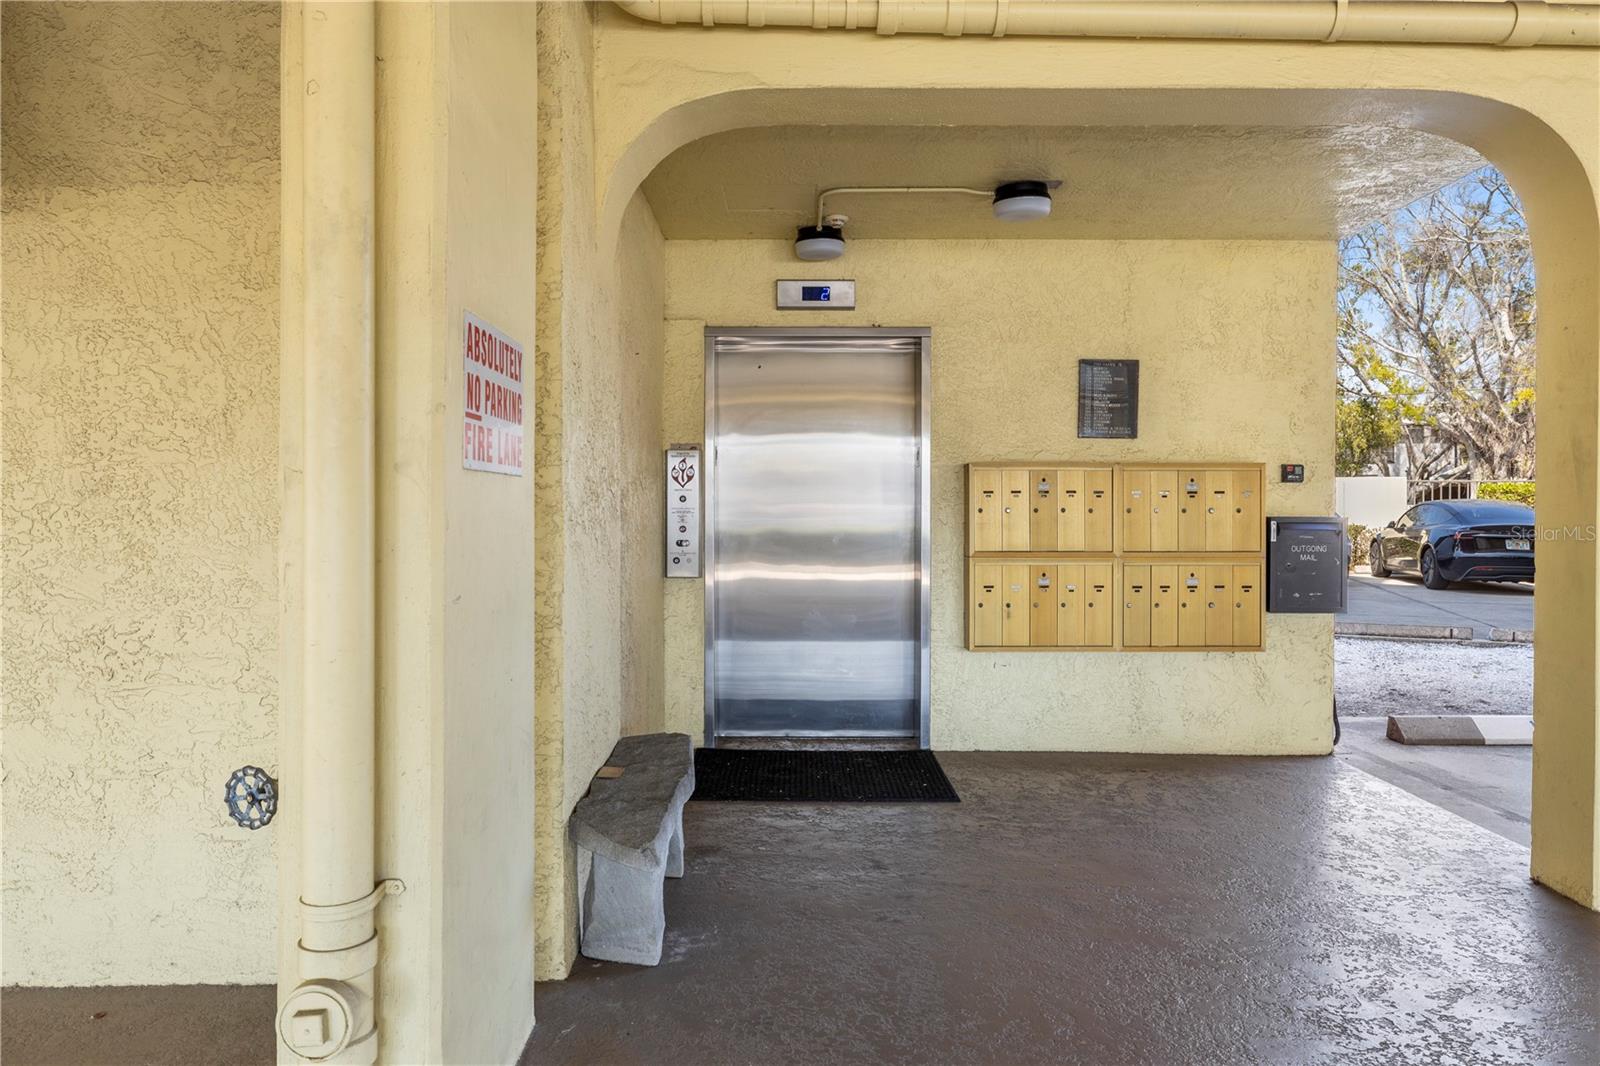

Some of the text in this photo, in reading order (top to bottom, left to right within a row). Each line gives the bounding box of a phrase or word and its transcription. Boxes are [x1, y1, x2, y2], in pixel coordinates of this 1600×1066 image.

[821, 287, 830, 300] 2
[466, 321, 522, 383] ABSOLUTELY
[466, 371, 522, 425] NO PARKING
[465, 421, 522, 468] FIRE LANE
[1291, 544, 1328, 553] OUTGOING
